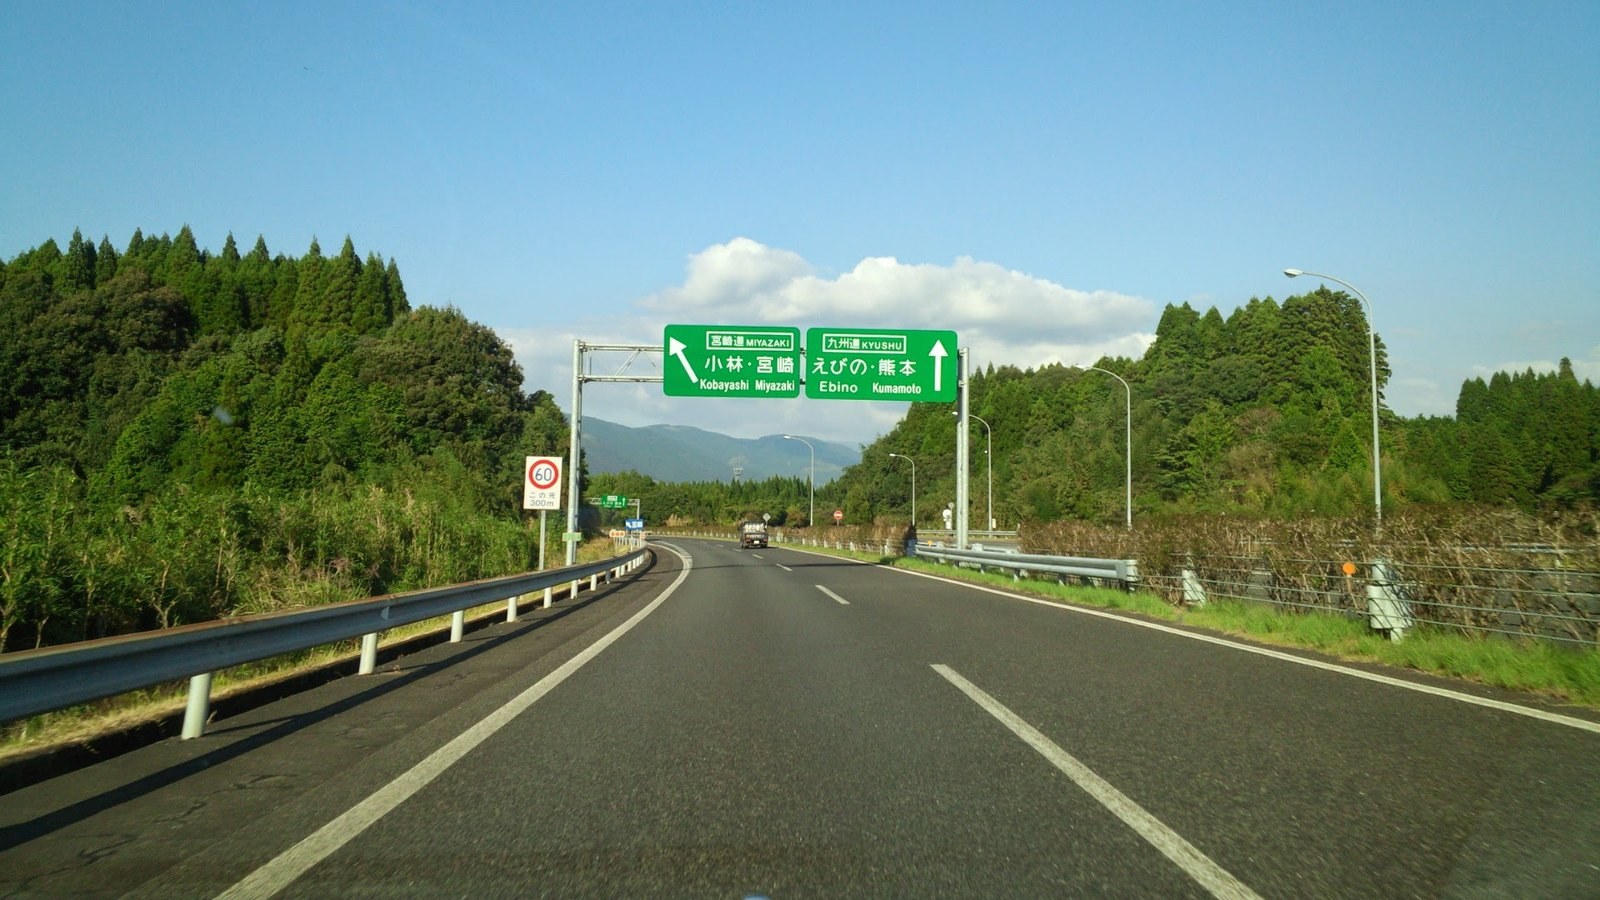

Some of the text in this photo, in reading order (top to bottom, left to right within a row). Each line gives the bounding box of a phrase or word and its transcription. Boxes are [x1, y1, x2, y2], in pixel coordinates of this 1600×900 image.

[746, 339, 790, 347] MIYAZAKI
[827, 338, 902, 350] 九州道 KYUSHU
[700, 378, 795, 393] Kobayashi Miyazaki
[819, 381, 922, 394] Ebino Kumamoto
[535, 468, 552, 481] 60
